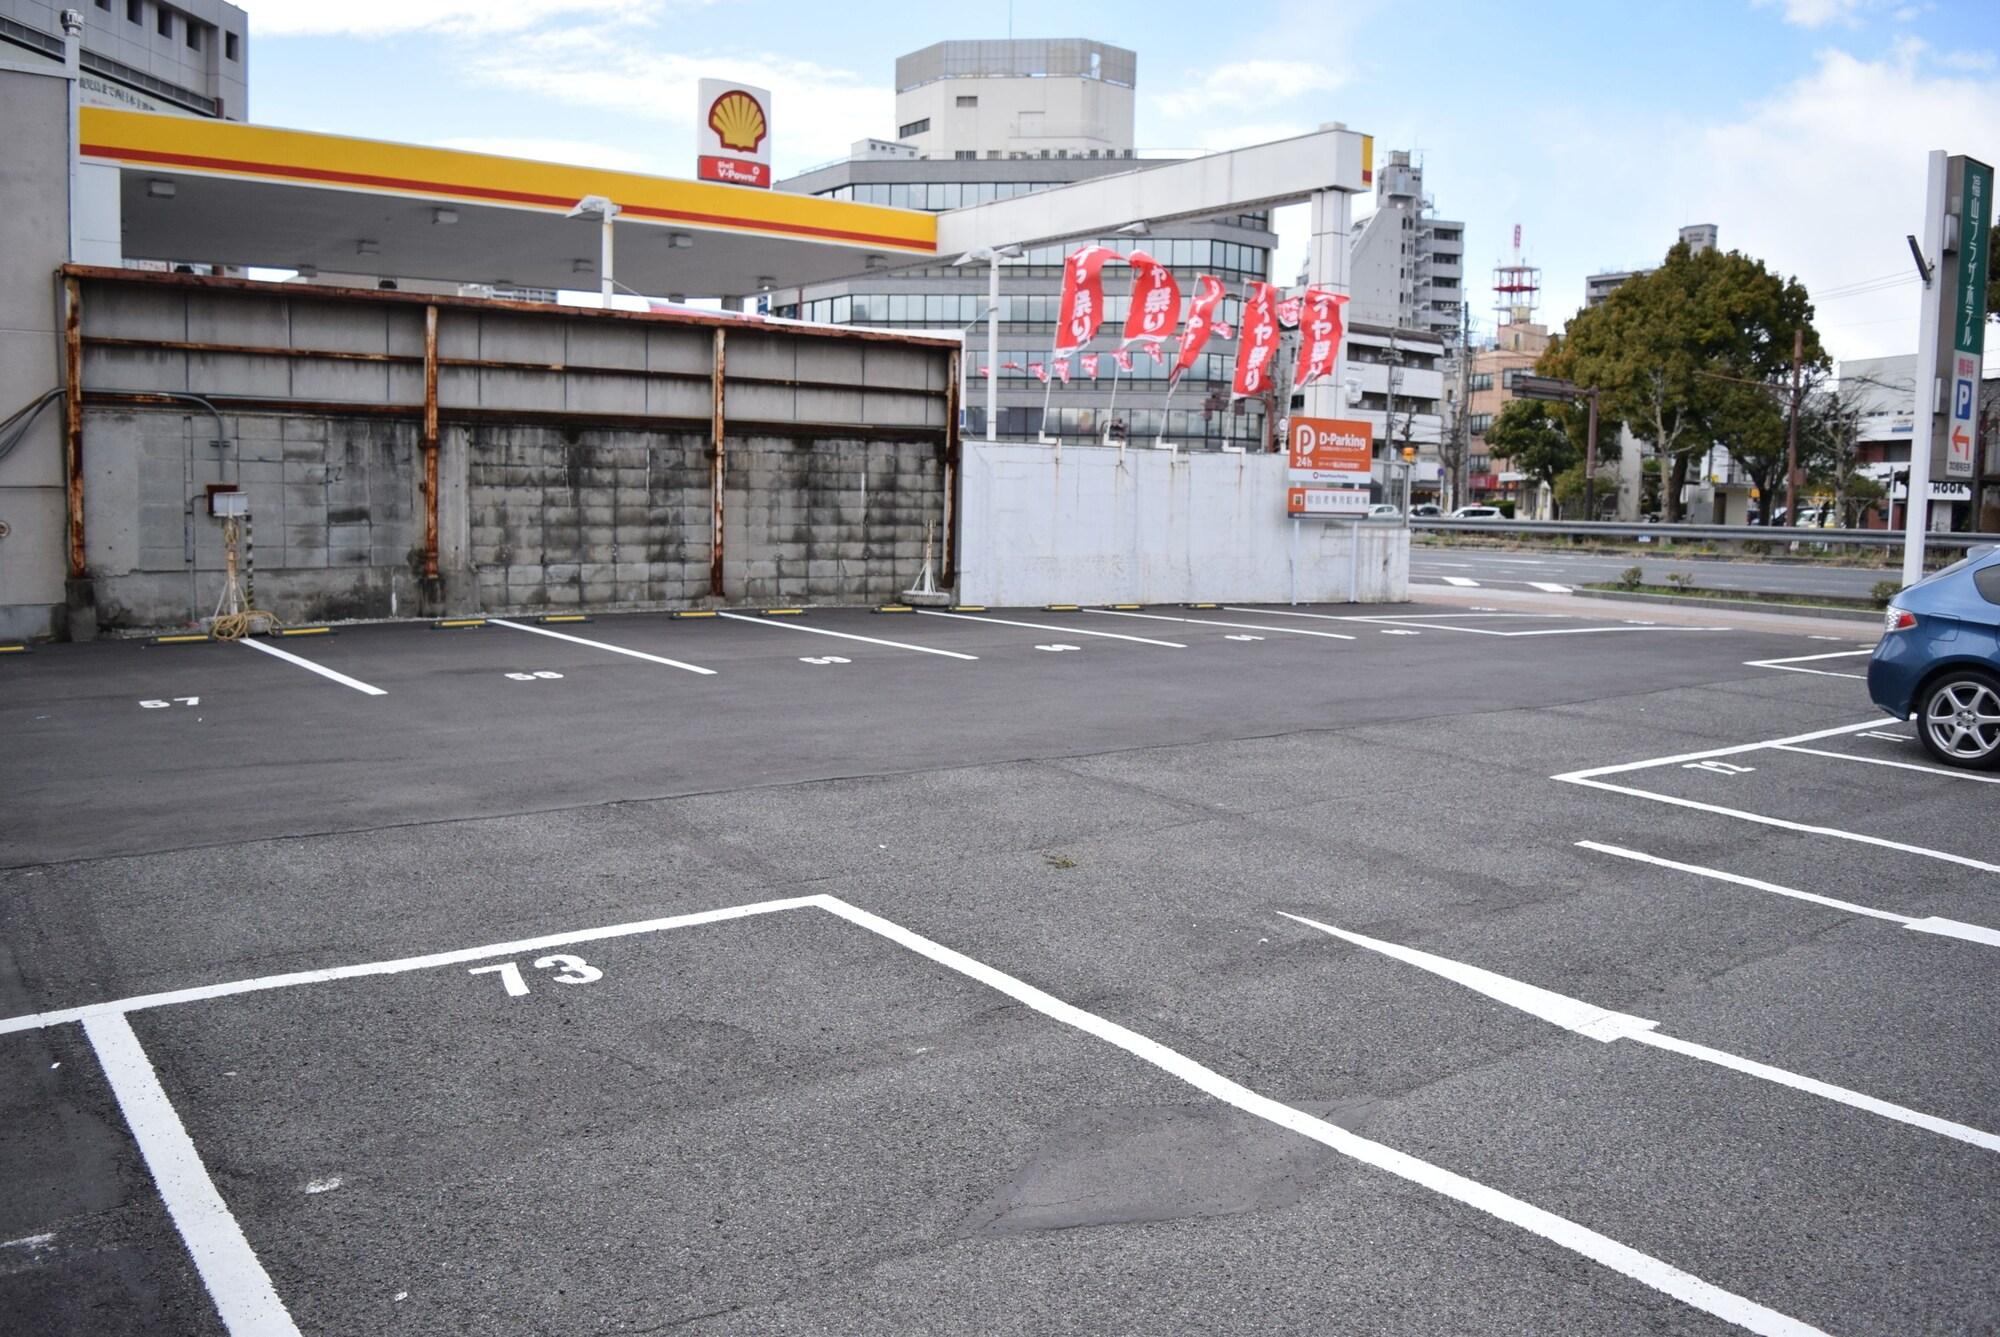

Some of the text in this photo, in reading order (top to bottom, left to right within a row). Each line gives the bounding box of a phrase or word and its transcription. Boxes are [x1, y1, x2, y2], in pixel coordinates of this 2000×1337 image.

[1319, 432, 1366, 451] D-Parking
[1296, 456, 1312, 467] 24h
[139, 696, 200, 709] 57
[468, 954, 603, 997] 73
